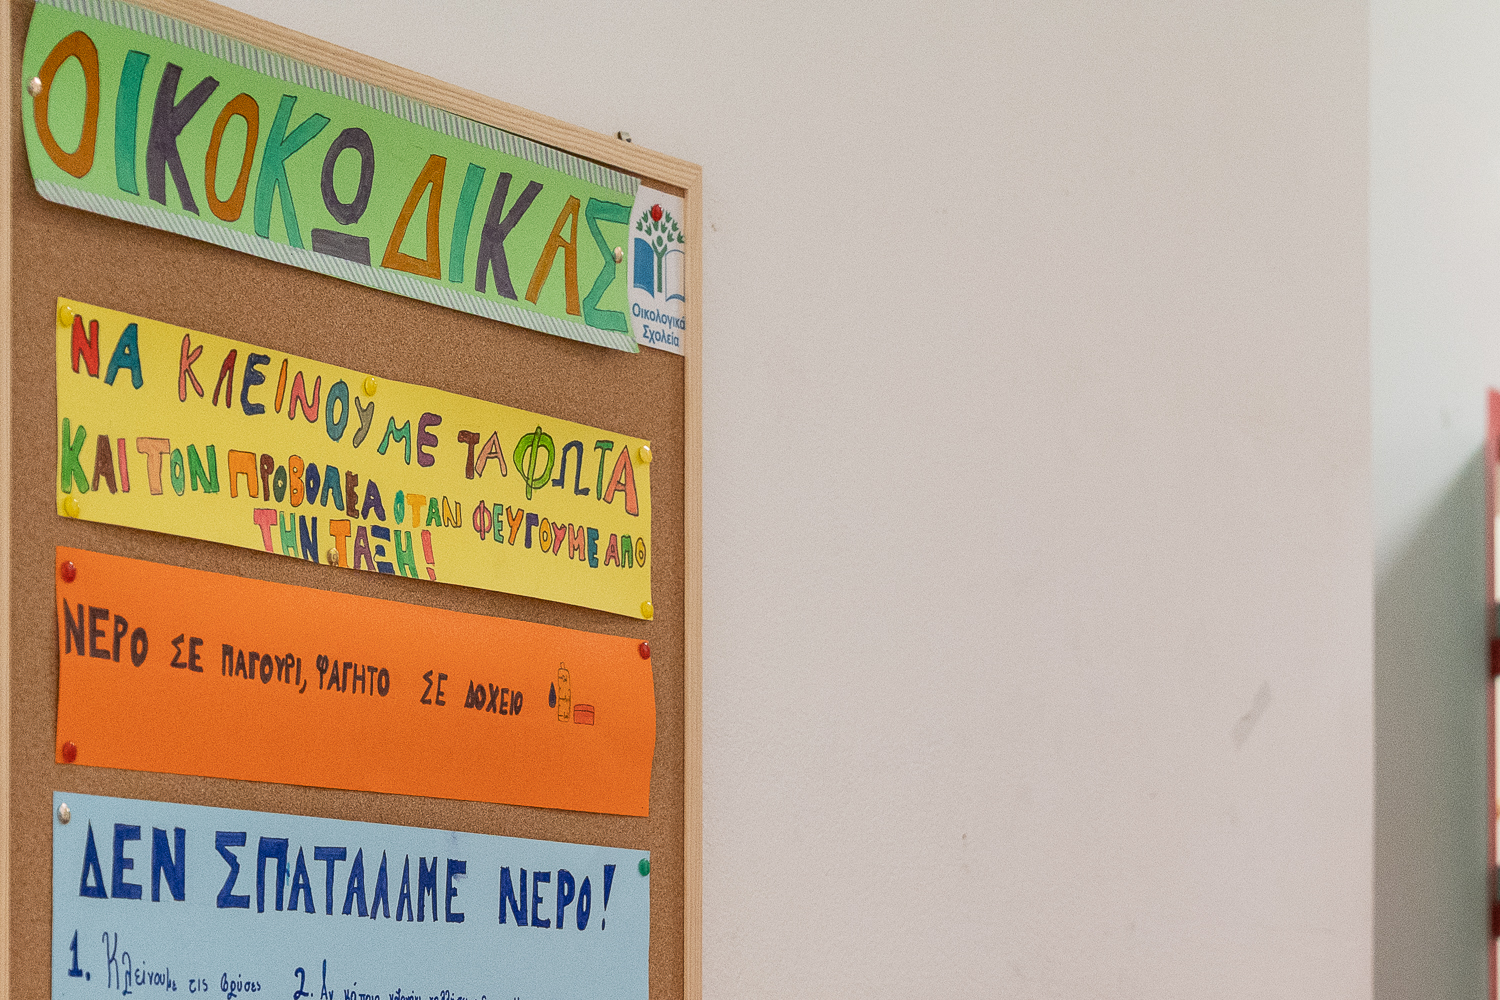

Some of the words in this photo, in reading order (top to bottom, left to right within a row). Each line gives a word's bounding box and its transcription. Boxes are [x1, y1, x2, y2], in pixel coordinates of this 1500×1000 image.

[632, 303, 686, 330] Οικολογικά
[643, 325, 680, 347] Σχολεία
[71, 314, 143, 389] ΝΑ
[178, 333, 442, 468] ΚΛΕΙΝΟΥΜΕ
[457, 430, 508, 479] ΤΑ
[513, 424, 639, 517] ΦΩΤΑ
[61, 417, 130, 494] ΚΑΙ
[136, 437, 220, 496] ΤΟΝ
[228, 449, 386, 521] ΠΡΟΒΟΛΕΑ
[394, 490, 462, 528] ΟΤΑΝ
[472, 500, 599, 568] ΦΕΥΓΟΥΜΕ
[604, 534, 646, 568] ΑΠΟ
[254, 508, 319, 564] ΤΗΝ
[329, 519, 436, 580] ΤΑΞΗ!
[63, 598, 148, 667] ΝΕΡΟ
[170, 633, 203, 673] ΣΕ
[222, 643, 307, 694] ΠΑΓΟΥΡΙ,
[420, 670, 448, 706] ΣΕ
[464, 680, 523, 716] ΔΟΧΕΙΟ
[79, 818, 186, 902] ΔΕΝ
[214, 831, 467, 924] ΣΠΑΤΑΛΑΜΕ
[499, 864, 616, 931] ΝΕΡΟ!
[67, 929, 91, 981] 1.
[189, 979, 208, 993] τις
[293, 967, 314, 1000] 2.
